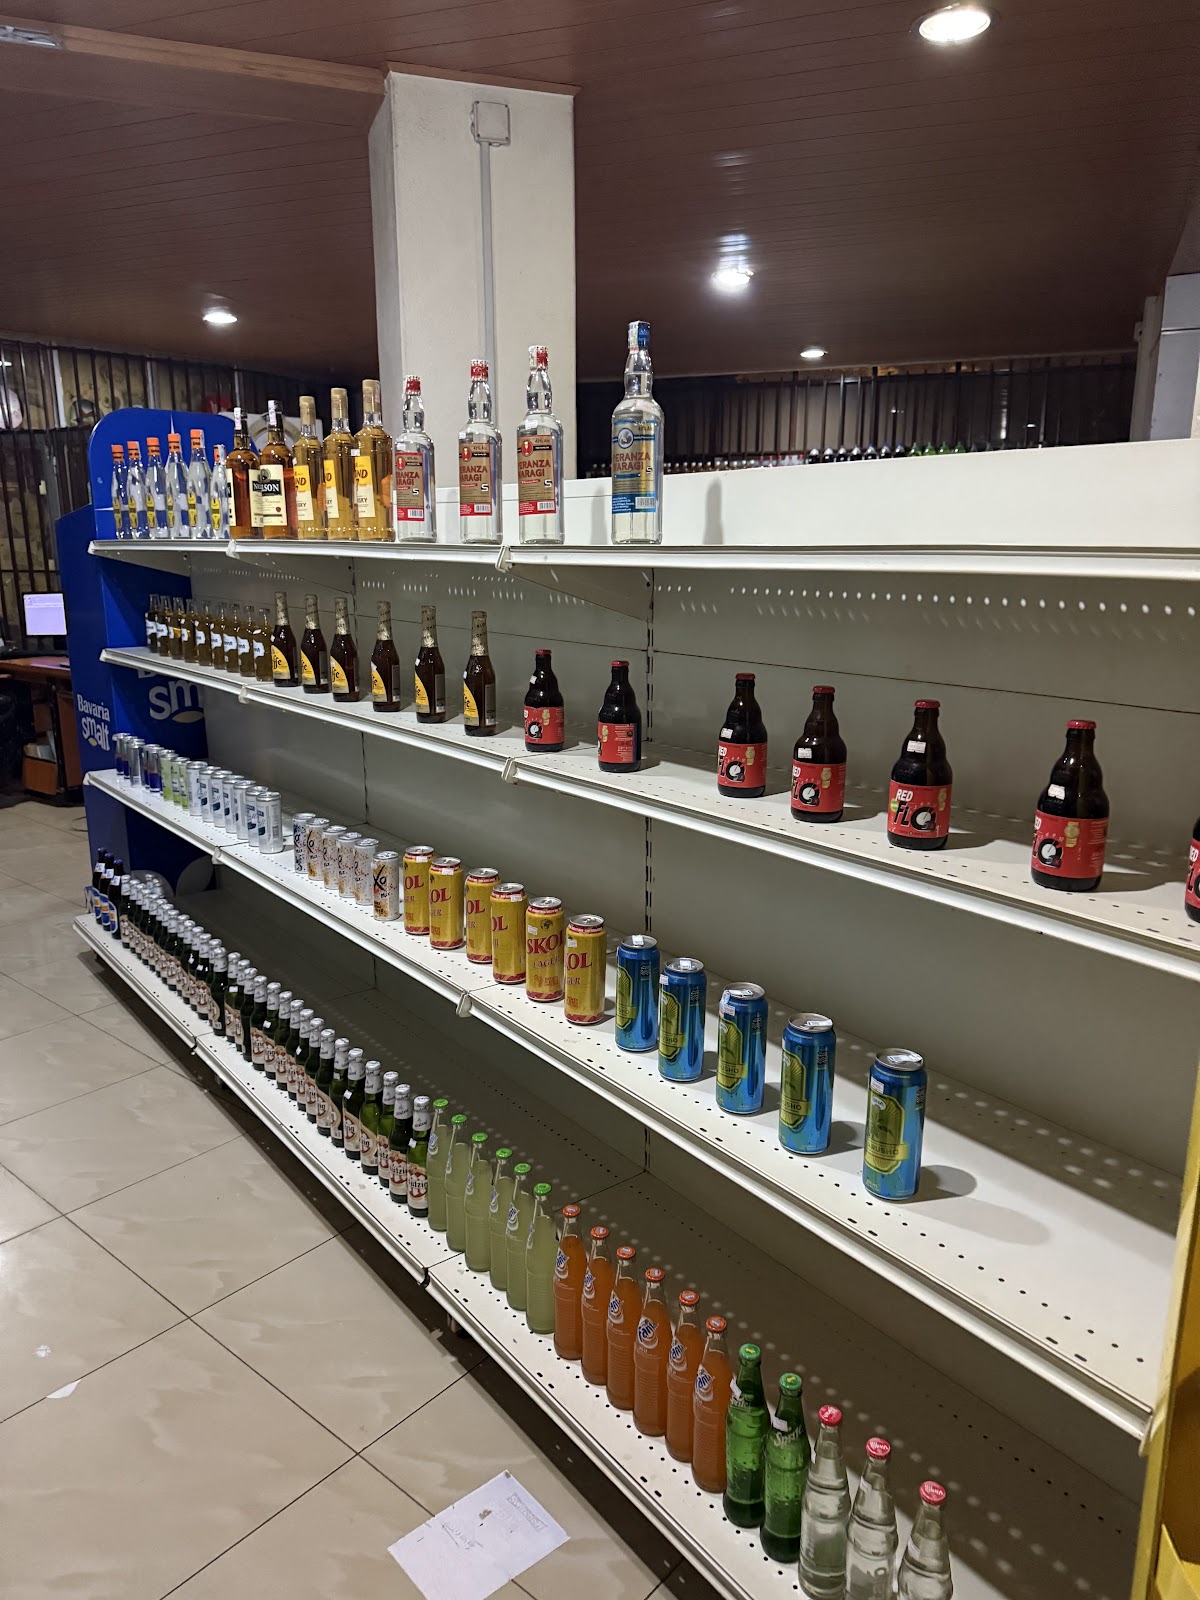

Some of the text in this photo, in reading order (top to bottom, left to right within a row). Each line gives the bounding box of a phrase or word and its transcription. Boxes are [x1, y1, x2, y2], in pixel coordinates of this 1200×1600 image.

[76, 693, 111, 723] Bavaria
[81, 716, 111, 752] smalt
[895, 788, 914, 802] RED
